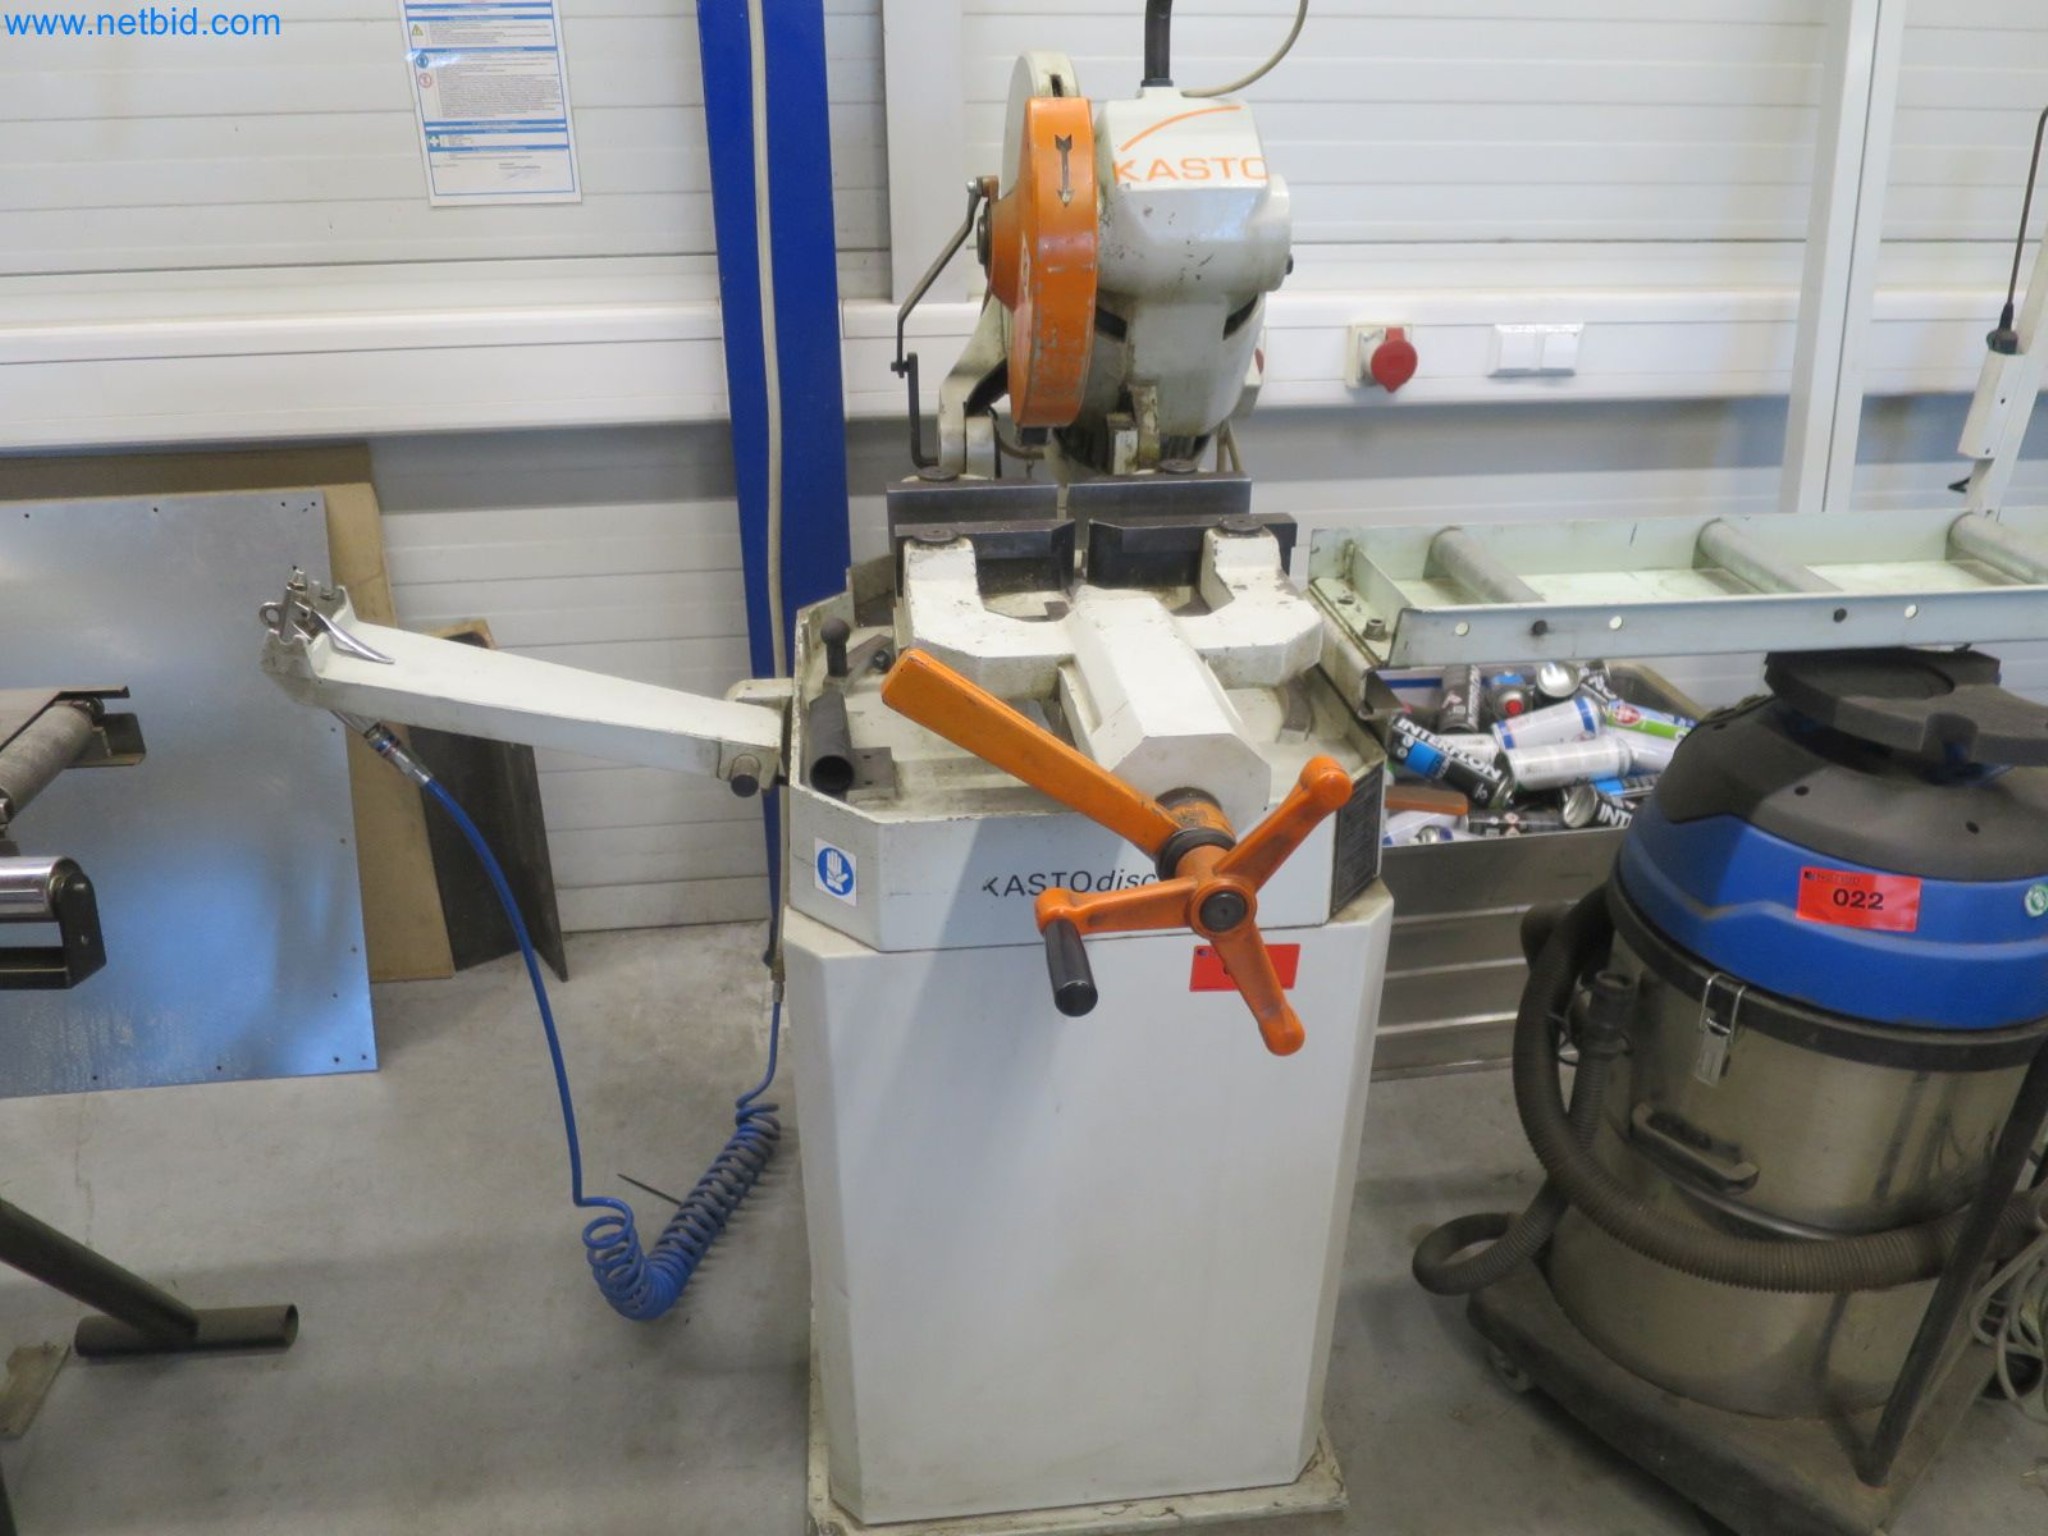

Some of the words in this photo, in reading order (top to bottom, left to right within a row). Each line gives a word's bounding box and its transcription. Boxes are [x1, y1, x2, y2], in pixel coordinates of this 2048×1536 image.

[1111, 156, 1270, 184] KASTO
[1397, 717, 1502, 780] INTERFLON
[1832, 888, 1884, 911] 022
